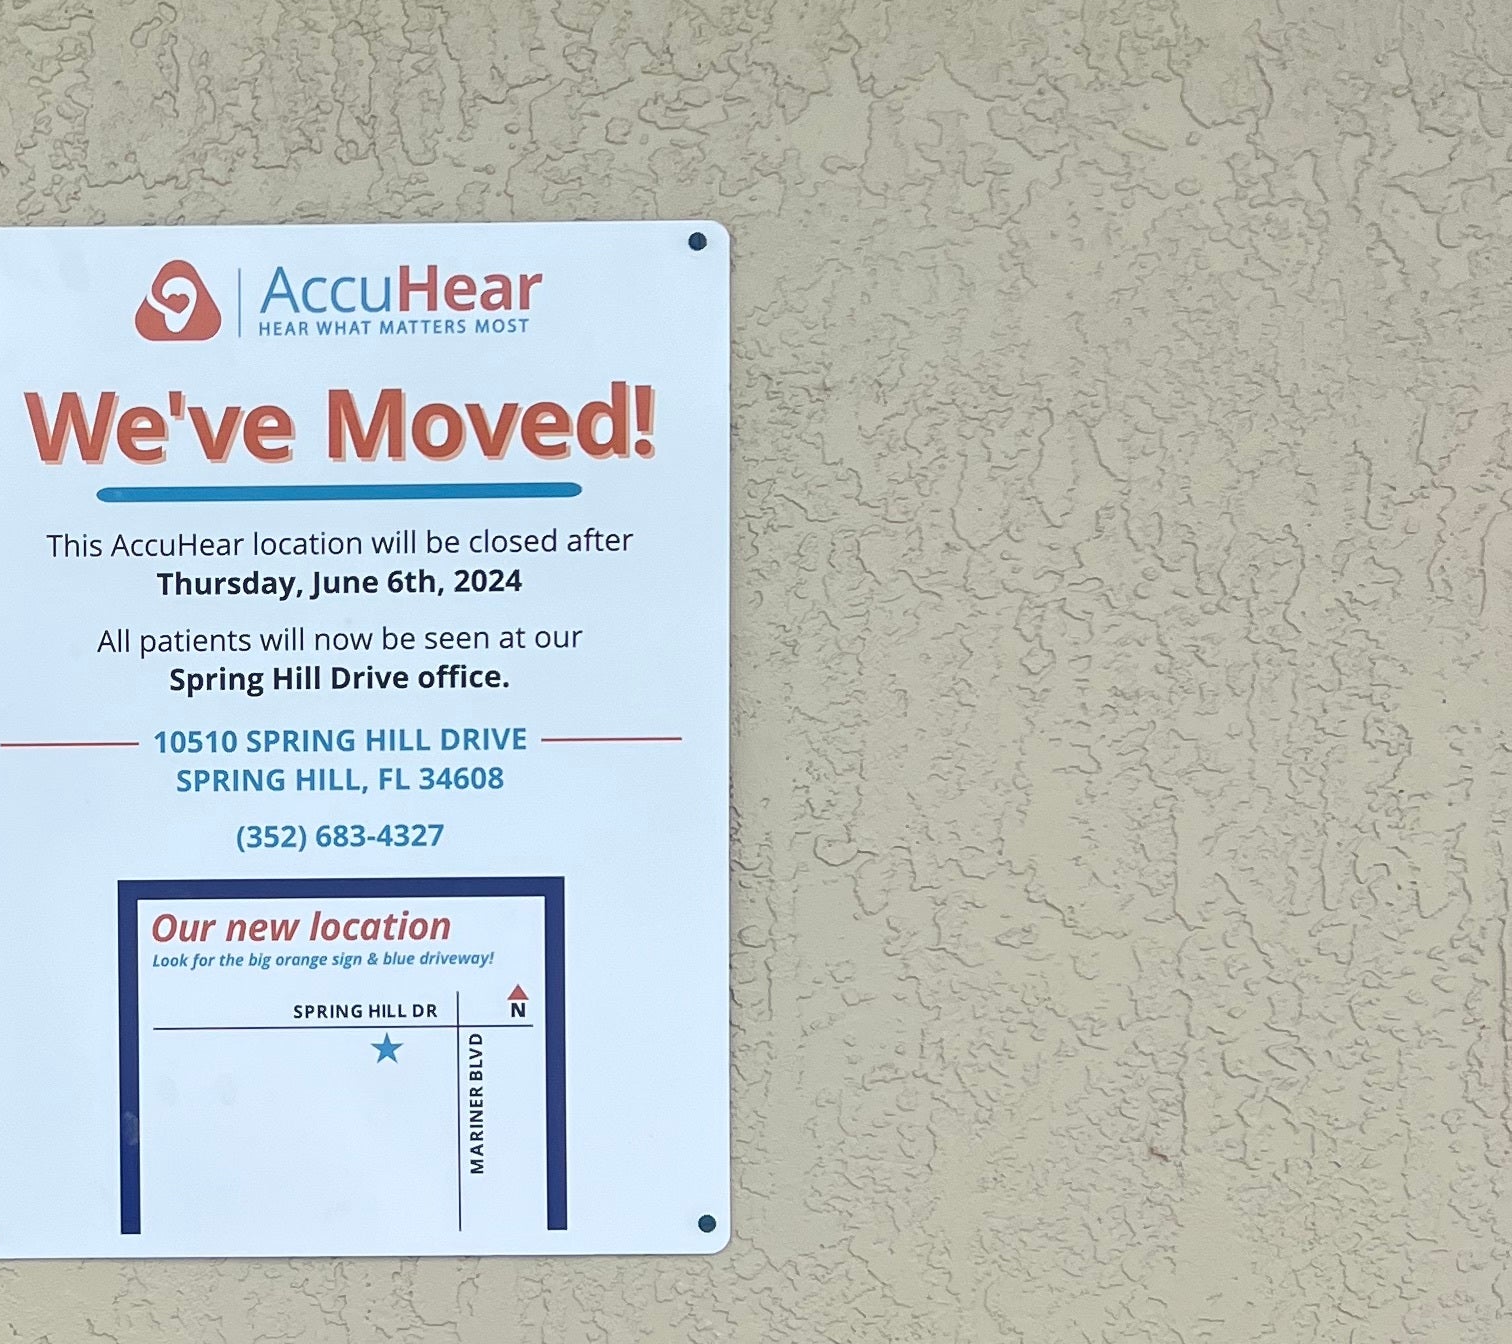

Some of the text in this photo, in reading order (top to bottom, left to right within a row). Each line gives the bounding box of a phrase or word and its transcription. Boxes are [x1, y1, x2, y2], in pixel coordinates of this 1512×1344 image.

[260, 265, 543, 313] AccuHear
[259, 319, 529, 336] HEAR WHAT MATTERS MOST
[24, 381, 655, 465] We've Moved!
[46, 528, 633, 557] This AccuHear location will be closed after
[157, 569, 522, 601] Thursday, June 6th, 2024
[97, 626, 583, 659] All patients will now be seen at our
[171, 664, 509, 697] Spring Hill Drive office.
[154, 728, 526, 753] 10510 SPRING HILL DRIVE
[177, 767, 503, 794] SPRING HILL, FL 34608
[237, 824, 444, 852] (352) 683-4327
[152, 910, 450, 942] Our new location
[153, 951, 494, 970] Look for the big orange sign & blue driveway!
[294, 1004, 437, 1018] SPRING HILL DR
[511, 1003, 525, 1017] N
[469, 1034, 483, 1174] MARINER BLVD
